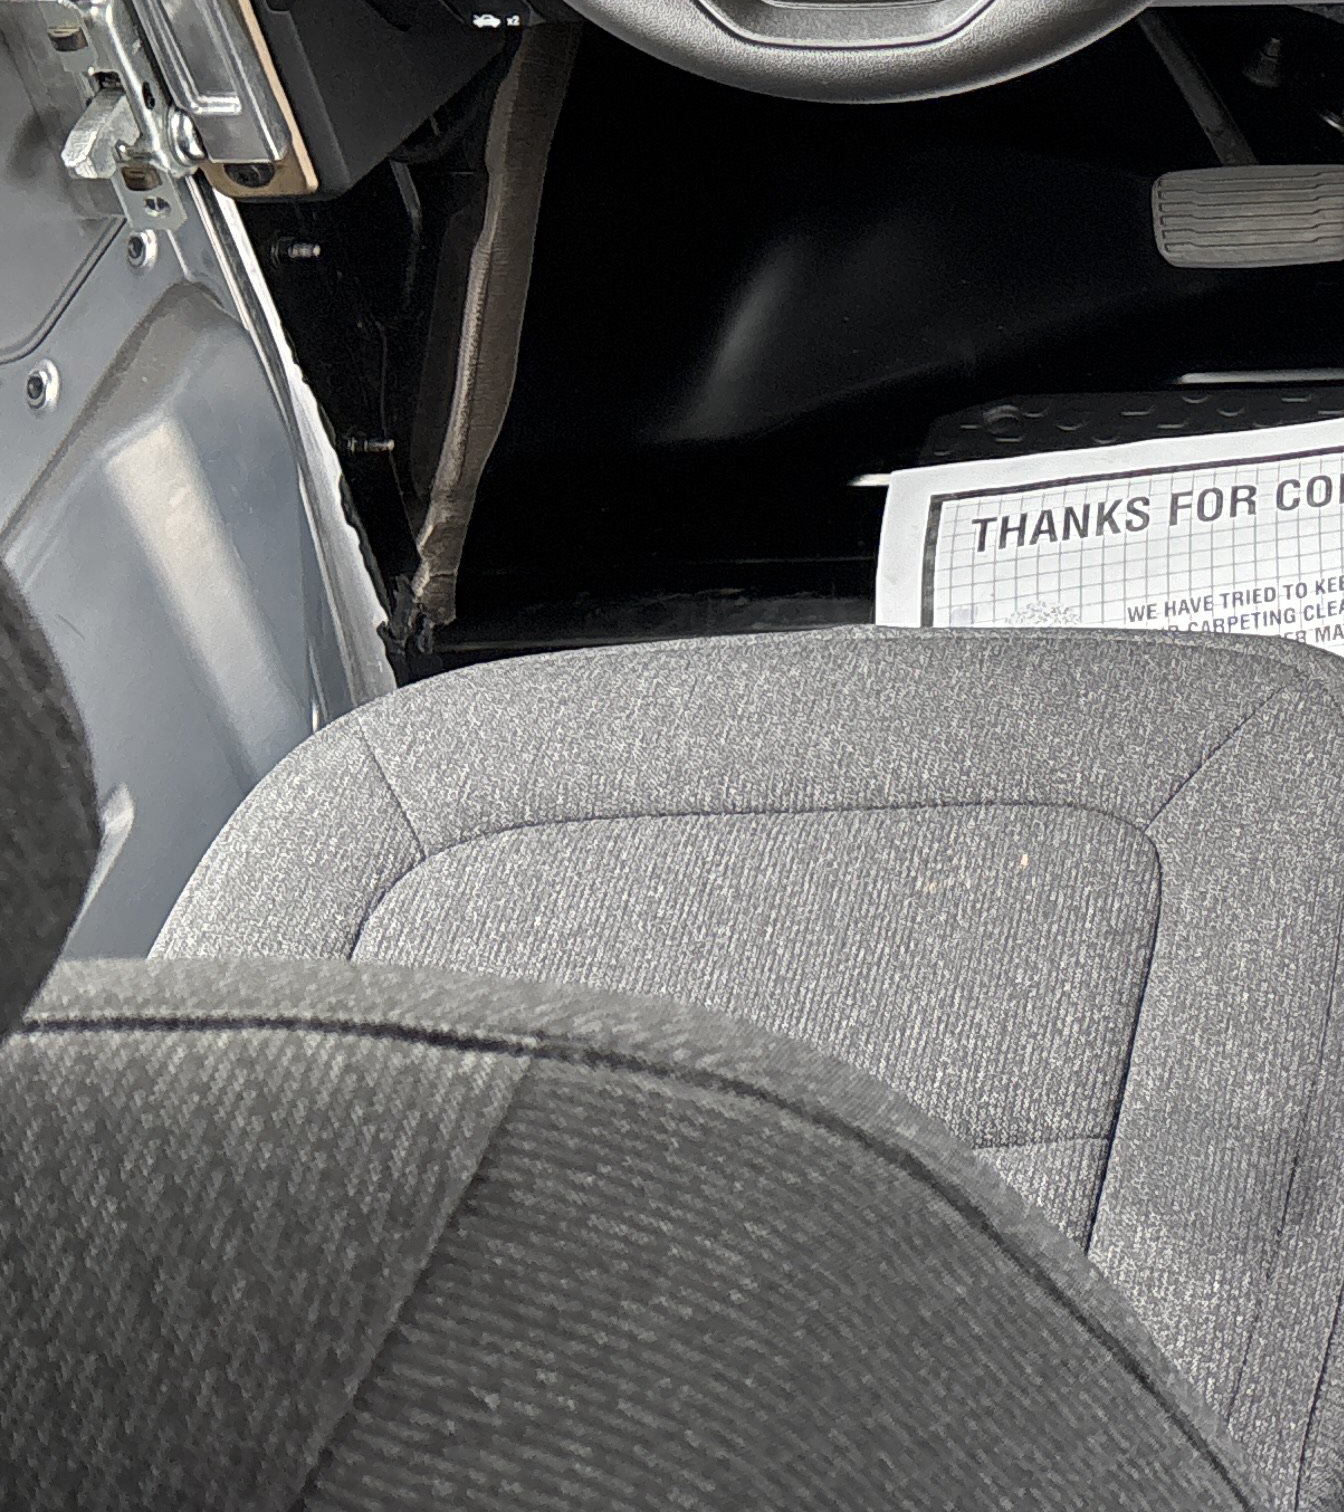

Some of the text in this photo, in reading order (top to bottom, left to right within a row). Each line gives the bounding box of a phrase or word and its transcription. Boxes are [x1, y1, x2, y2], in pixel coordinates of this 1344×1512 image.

[506, 14, 521, 27] x2
[970, 495, 1151, 553] THANKS
[1168, 485, 1258, 528] FOR
[1127, 603, 1158, 624] WE
[1163, 594, 1214, 618] HAVE
[1218, 585, 1277, 610] TRIED
[1282, 581, 1307, 601] TO
[1187, 607, 1297, 634] CARPETING
